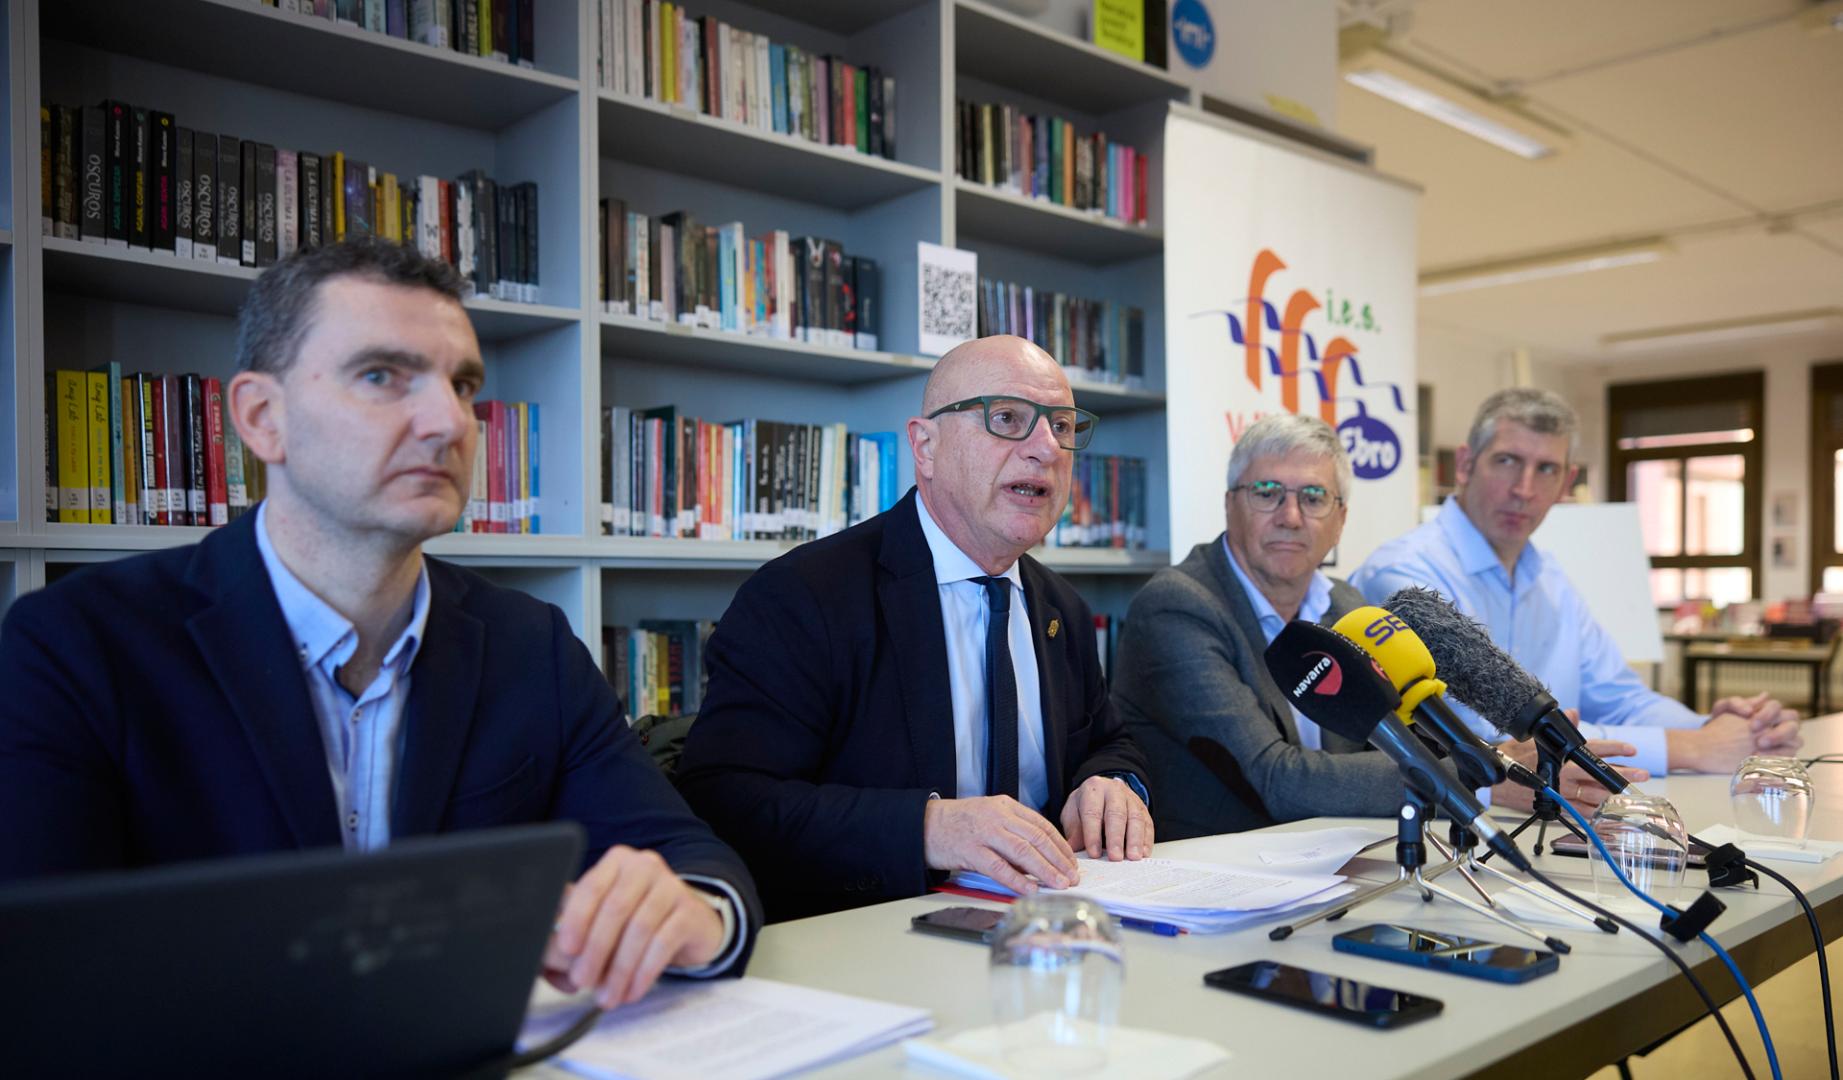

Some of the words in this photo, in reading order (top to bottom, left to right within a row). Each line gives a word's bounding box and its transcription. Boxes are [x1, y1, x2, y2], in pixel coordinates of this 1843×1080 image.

[84, 154, 102, 219] OSCUROS
[181, 180, 192, 229] OSCUROS
[196, 174, 212, 236] OSCUROS
[226, 186, 238, 237] OSCUROS
[263, 192, 274, 243] OSCUROS
[1326, 288, 1381, 333] i.e.s.
[1339, 425, 1397, 470] Ebro
[1293, 656, 1332, 698] Navarra
